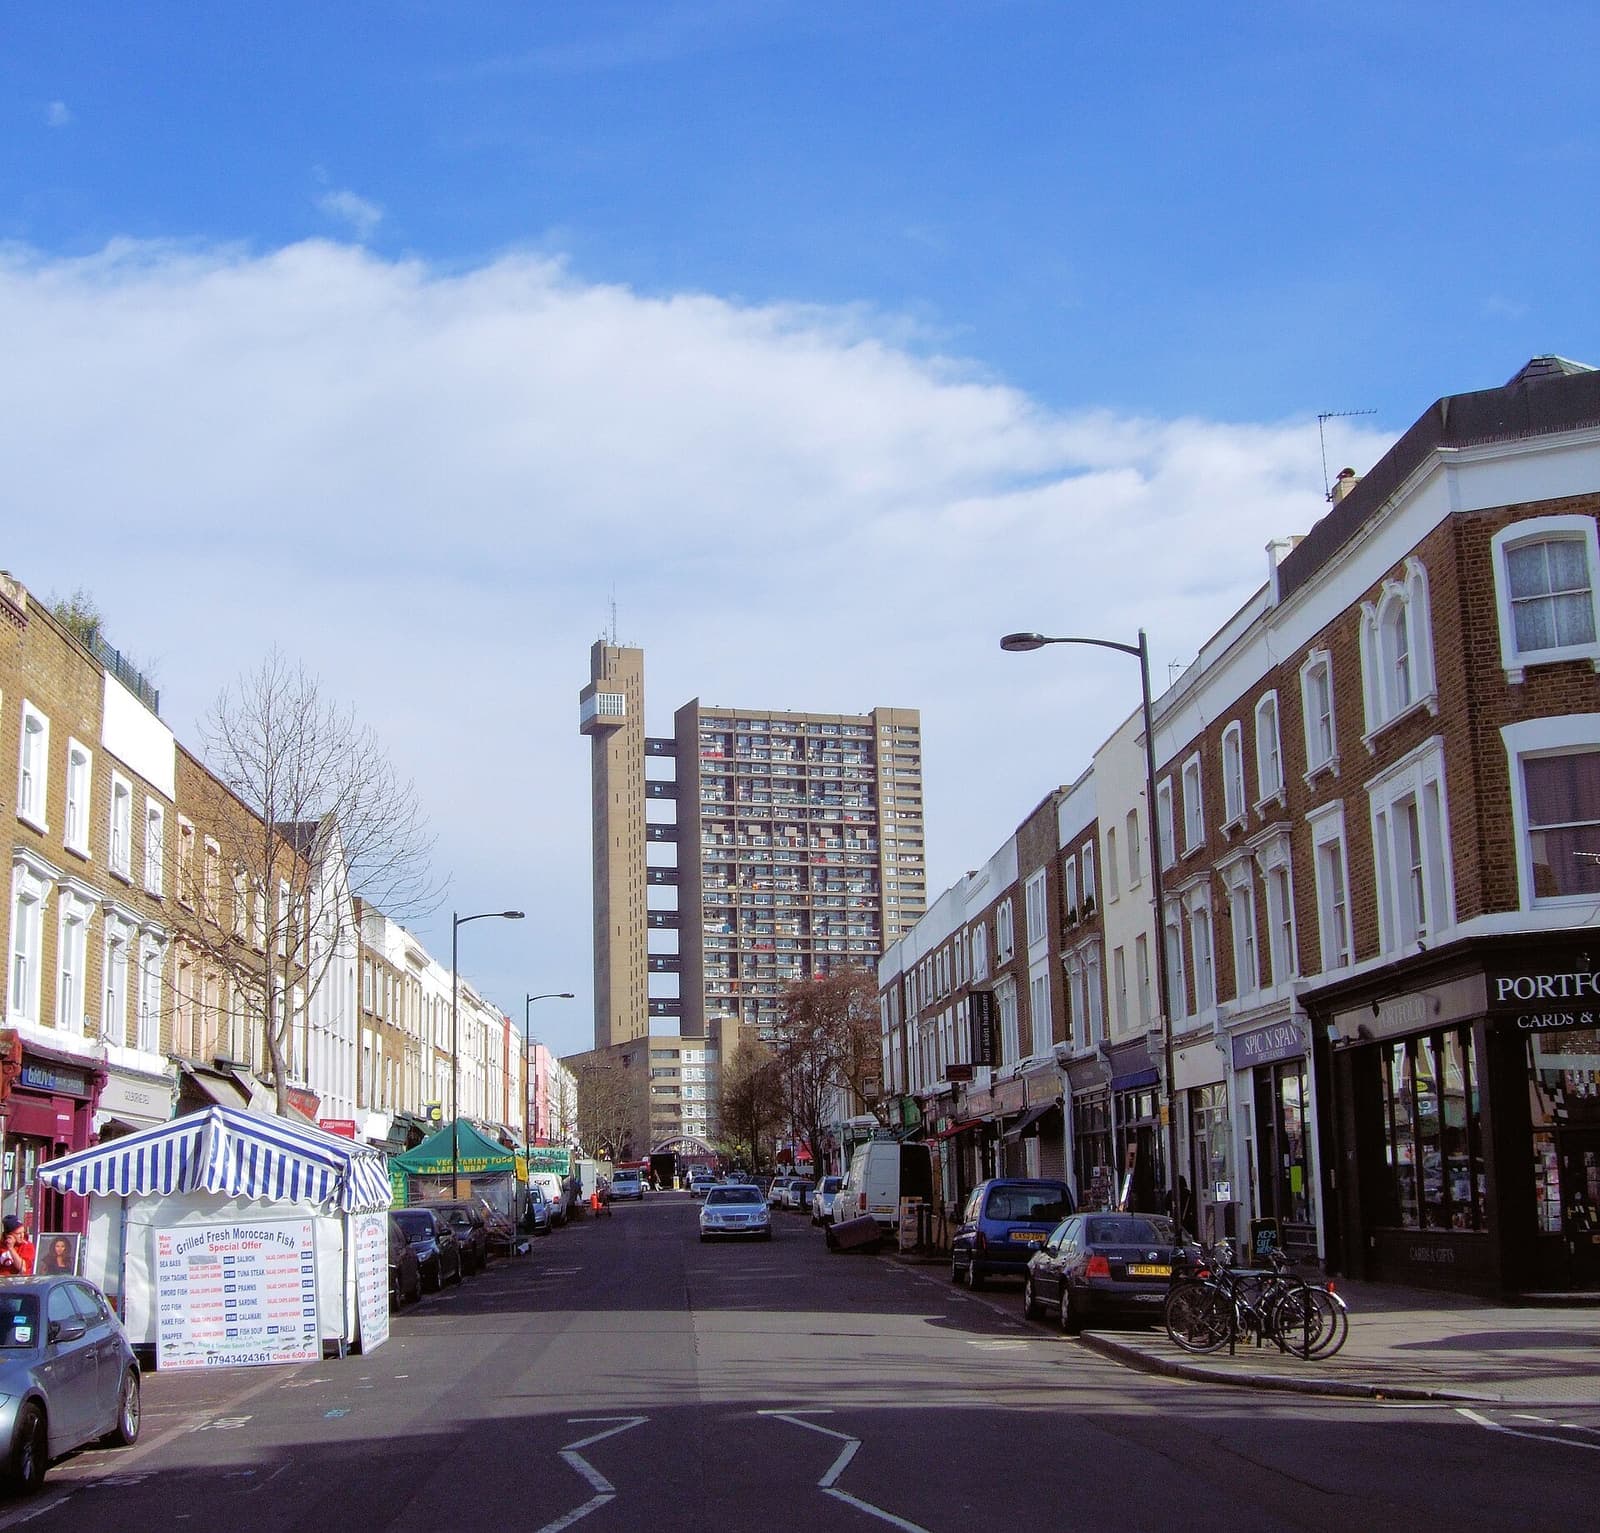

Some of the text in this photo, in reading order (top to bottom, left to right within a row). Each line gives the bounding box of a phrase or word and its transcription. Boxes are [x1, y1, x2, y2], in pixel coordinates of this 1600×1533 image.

[1517, 1011, 1594, 1029] CARDS &
[1245, 1034, 1263, 1056] SPIC
[1274, 1024, 1298, 1049] SPAN
[436, 1158, 488, 1166] VEGTARIAN
[491, 1156, 513, 1164] FOOD
[176, 1228, 295, 1255] Grilled Fresh Moroccan Fish
[208, 1241, 262, 1253] Special Offer
[207, 1352, 270, 1365] 07943424361
